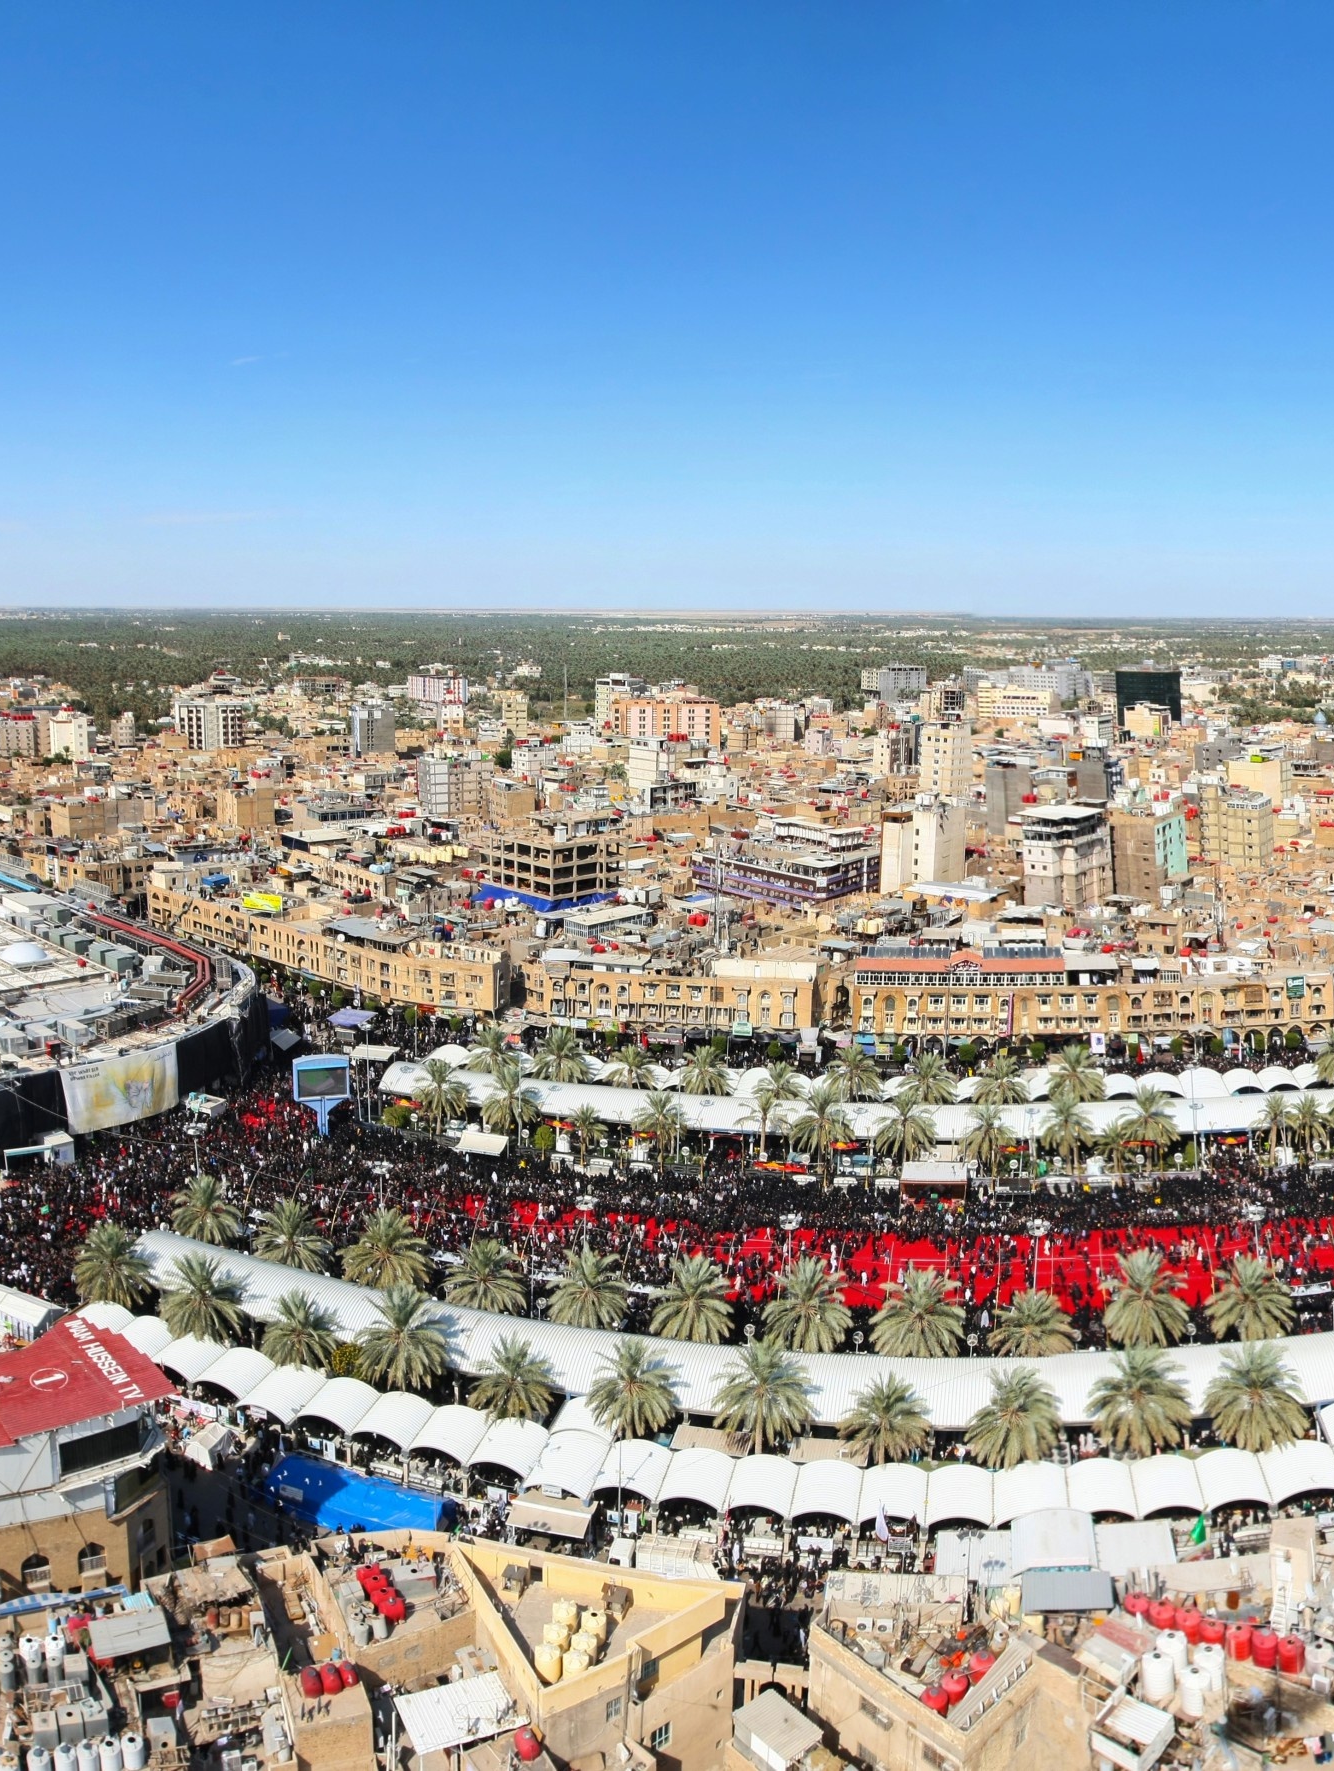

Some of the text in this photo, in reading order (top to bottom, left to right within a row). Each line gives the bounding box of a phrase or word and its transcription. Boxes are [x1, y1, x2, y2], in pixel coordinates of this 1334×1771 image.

[33, 1373, 65, 1385] 1
[64, 1319, 145, 1399] IMAM HUSSEIN TV
